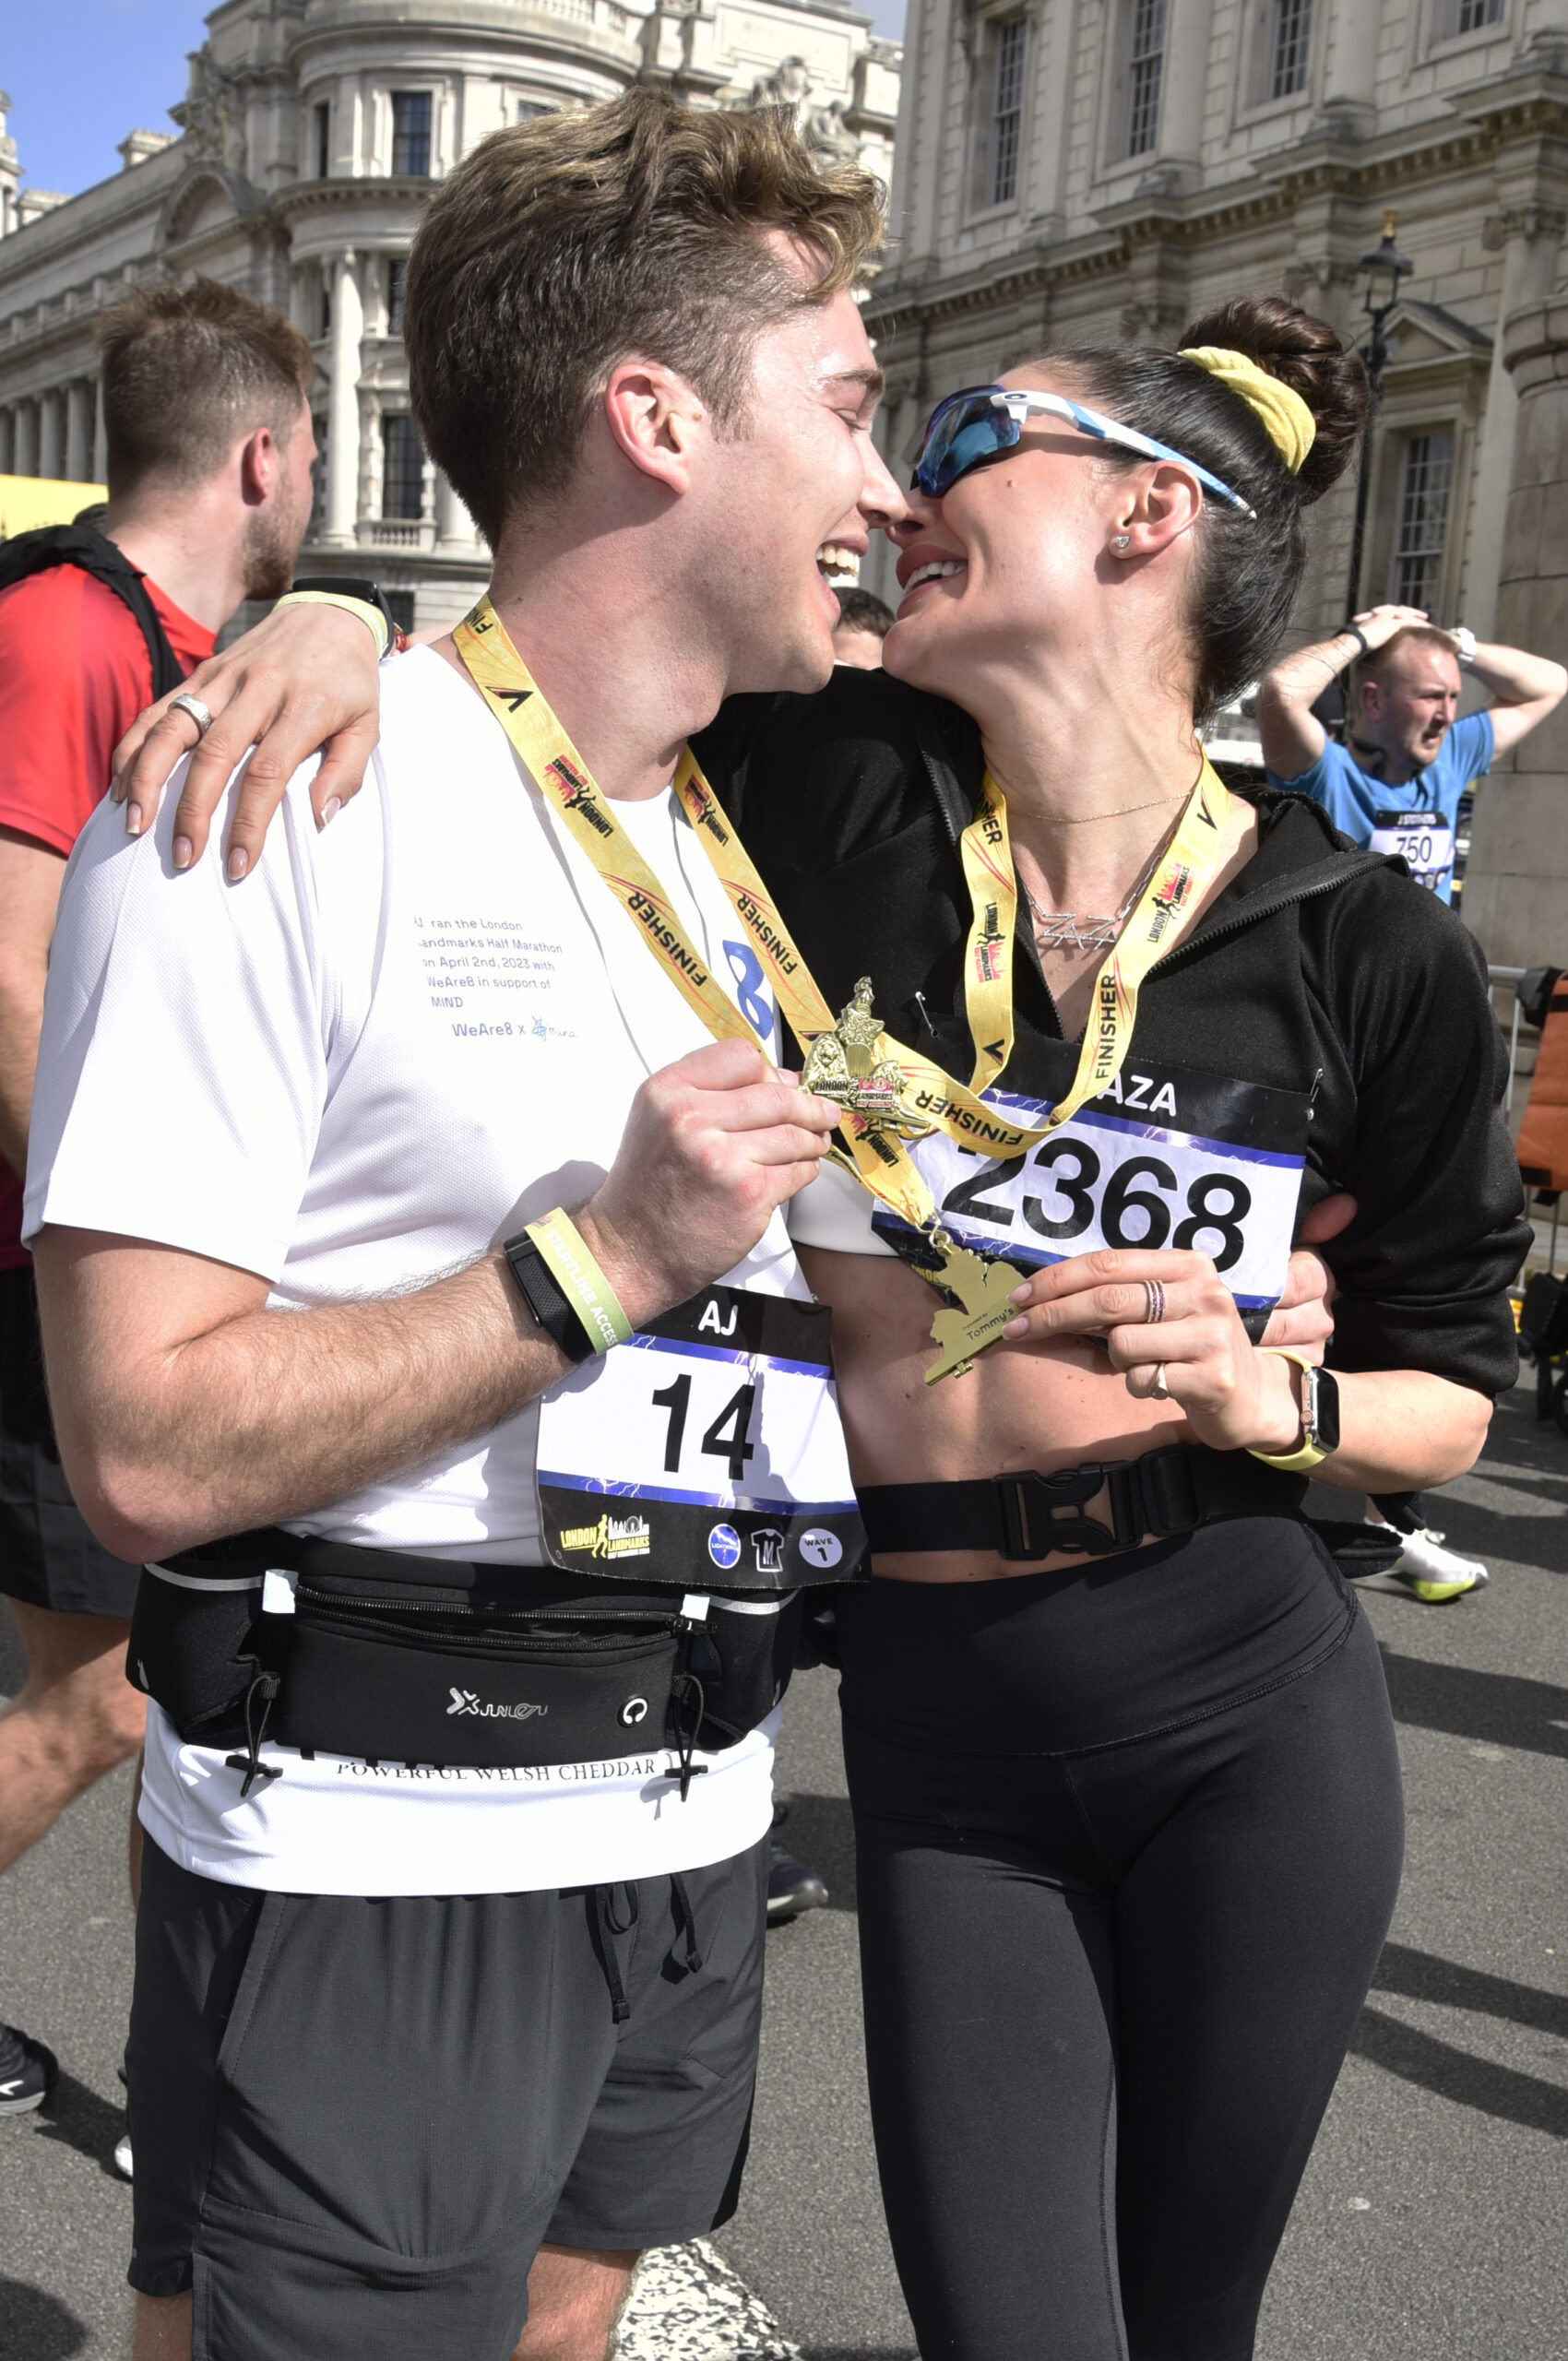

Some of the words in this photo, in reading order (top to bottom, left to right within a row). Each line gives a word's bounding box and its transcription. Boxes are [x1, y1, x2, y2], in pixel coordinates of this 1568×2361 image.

[577, 801, 614, 838] LONDON
[705, 814, 729, 847] LONDON
[984, 902, 998, 934] LONDON
[1146, 909, 1168, 943] LONDON
[1171, 866, 1190, 905] LANDMARKS
[431, 919, 452, 929] ran
[455, 919, 477, 929] the
[480, 918, 523, 931] London
[628, 891, 707, 987] FINISHER
[737, 893, 798, 975] FINISHER
[419, 937, 484, 948] andmarks
[487, 937, 509, 949] Half
[512, 939, 563, 954] Marathon
[440, 956, 469, 969] April
[502, 957, 530, 969] 2023
[532, 959, 554, 971] with
[478, 977, 490, 987] in
[493, 979, 538, 990] support
[540, 979, 551, 989] of
[431, 995, 464, 1008] MIND
[451, 1021, 513, 1037] WeAre8
[1096, 975, 1116, 1079] FINISHER
[814, 1080, 849, 1092] LONDON
[915, 1090, 1024, 1146] FINISHER
[867, 1133, 899, 1169] LONDON
[942, 1135, 1252, 1274] 2368
[590, 1306, 619, 1347] ACCESS
[698, 1300, 738, 1335] AJ
[967, 1308, 1014, 1340] Tommy's
[652, 1373, 756, 1480] 14
[560, 1526, 598, 1548] LONDON
[608, 1536, 649, 1552] LANDMARKS
[804, 1537, 833, 1548] WAVE
[817, 1548, 827, 1561] 1
[475, 1766, 550, 1781] WELSH
[559, 1758, 655, 1780] CHEDDAR
